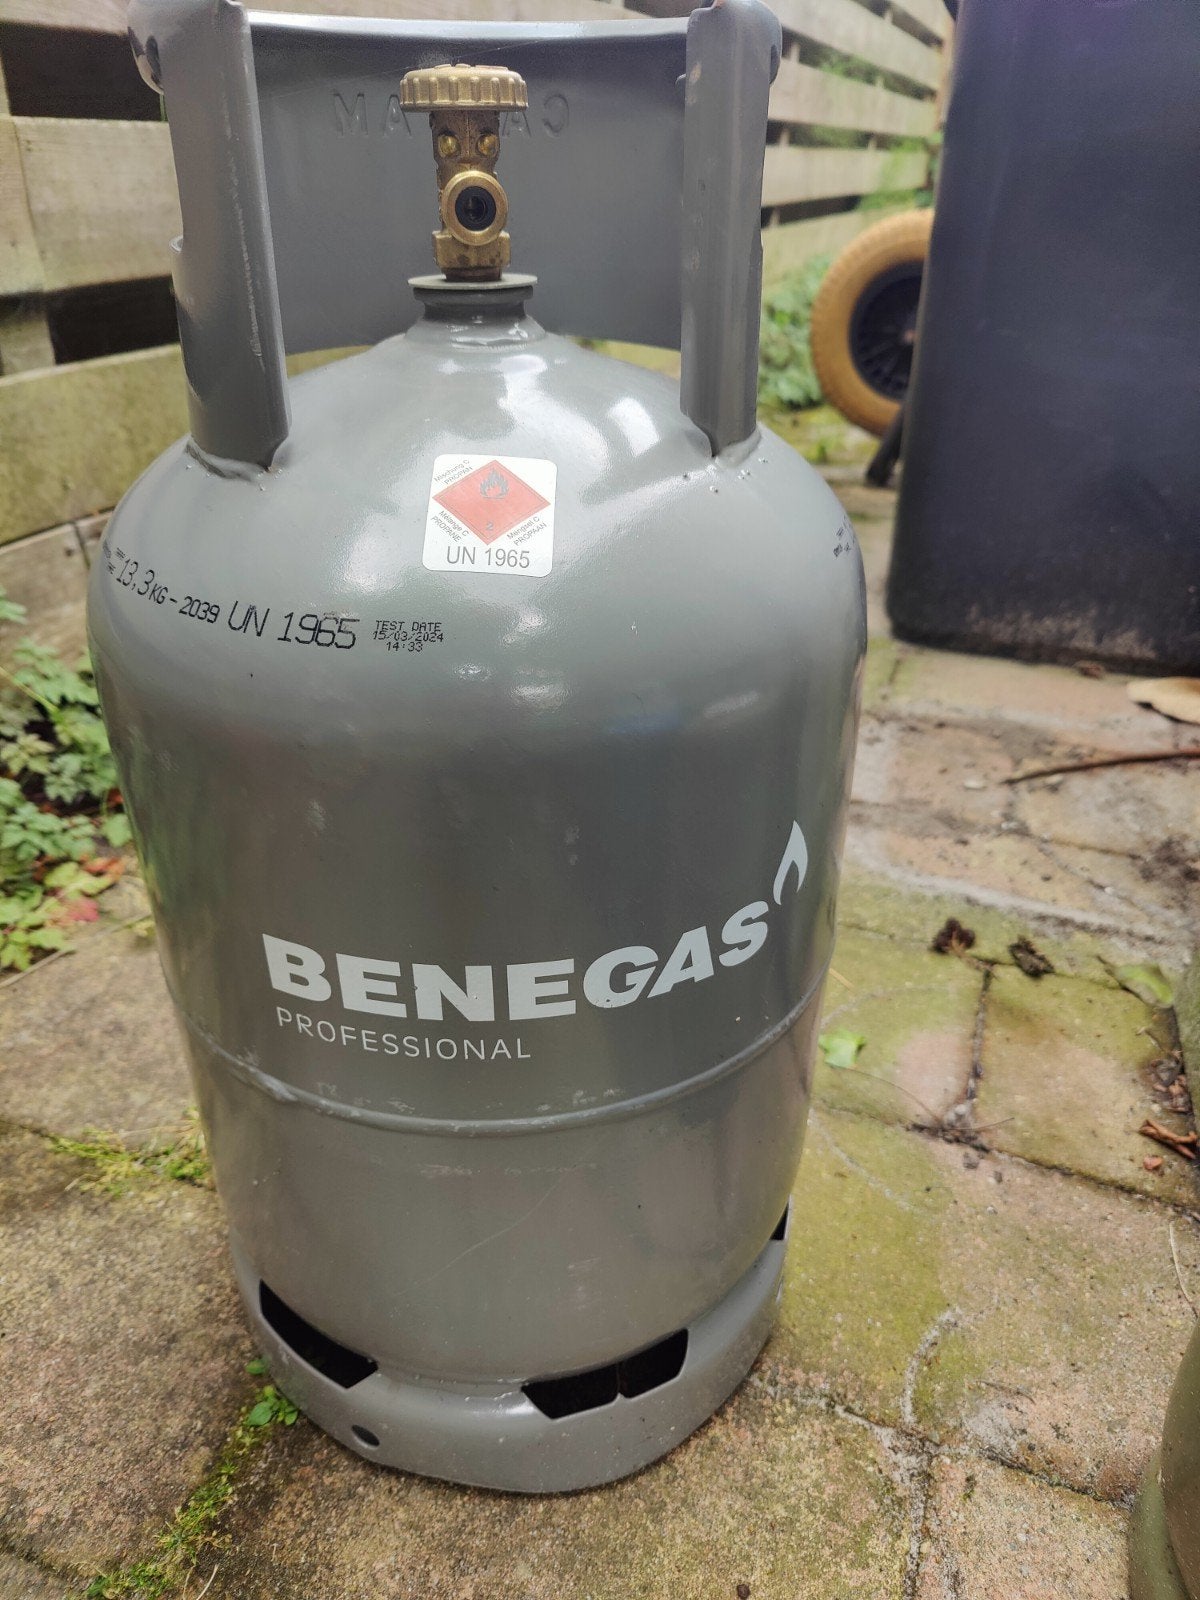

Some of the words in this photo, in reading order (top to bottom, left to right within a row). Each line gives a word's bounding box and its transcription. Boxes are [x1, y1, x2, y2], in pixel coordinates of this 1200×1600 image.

[444, 466, 473, 484] PROPAN
[431, 515, 461, 542] PROPANE
[486, 521, 494, 531] 2
[513, 522, 547, 546] PROPAAN
[446, 546, 476, 565] UN
[485, 548, 530, 569] 1965
[179, 596, 221, 624] 2039
[228, 600, 270, 637] UN
[277, 612, 360, 649] 1965
[375, 620, 405, 632] TEST
[412, 621, 442, 632] DATE
[372, 631, 444, 643] 15/03/2024
[386, 641, 423, 652] 14:33
[262, 900, 770, 1022] BENEGAS
[275, 1006, 532, 1061] PROFESSIONAL
